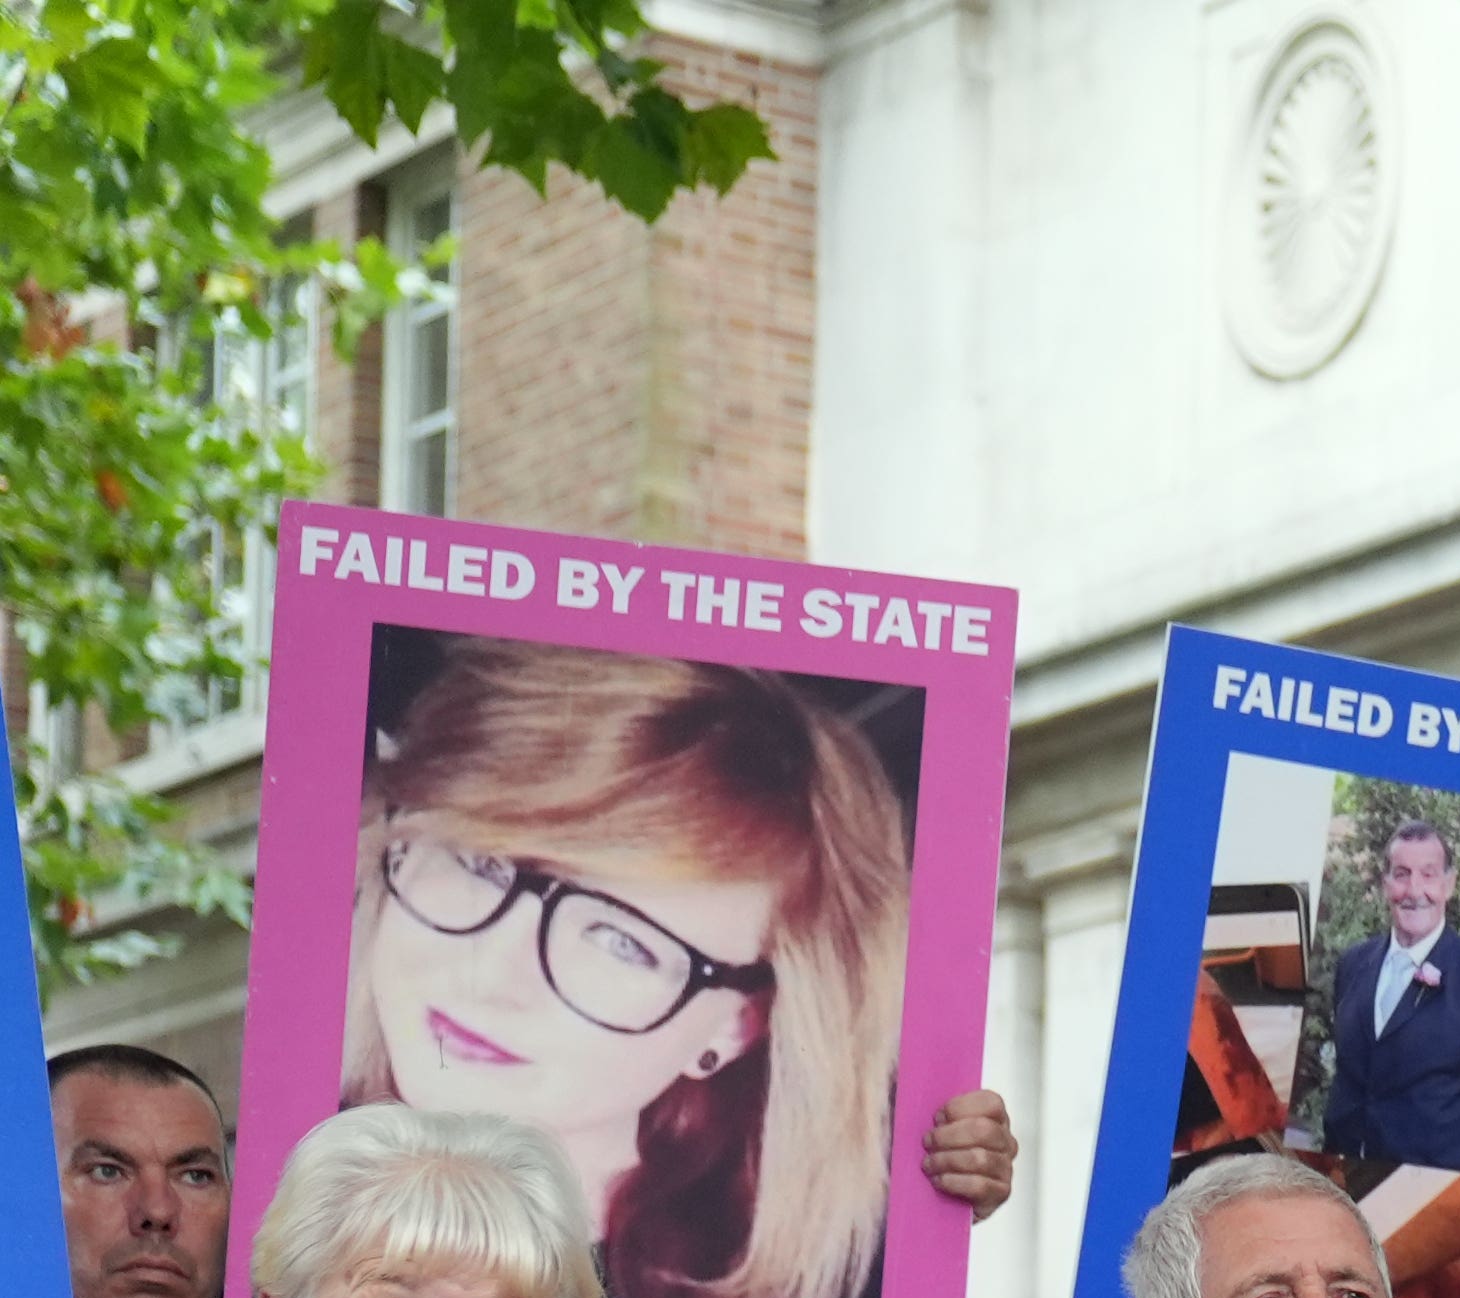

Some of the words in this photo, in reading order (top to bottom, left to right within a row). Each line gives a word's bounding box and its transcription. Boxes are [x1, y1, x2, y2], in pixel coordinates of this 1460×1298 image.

[299, 525, 536, 601] FAILED
[556, 557, 645, 614] BY
[660, 570, 785, 633] THE
[799, 588, 992, 657] STATE
